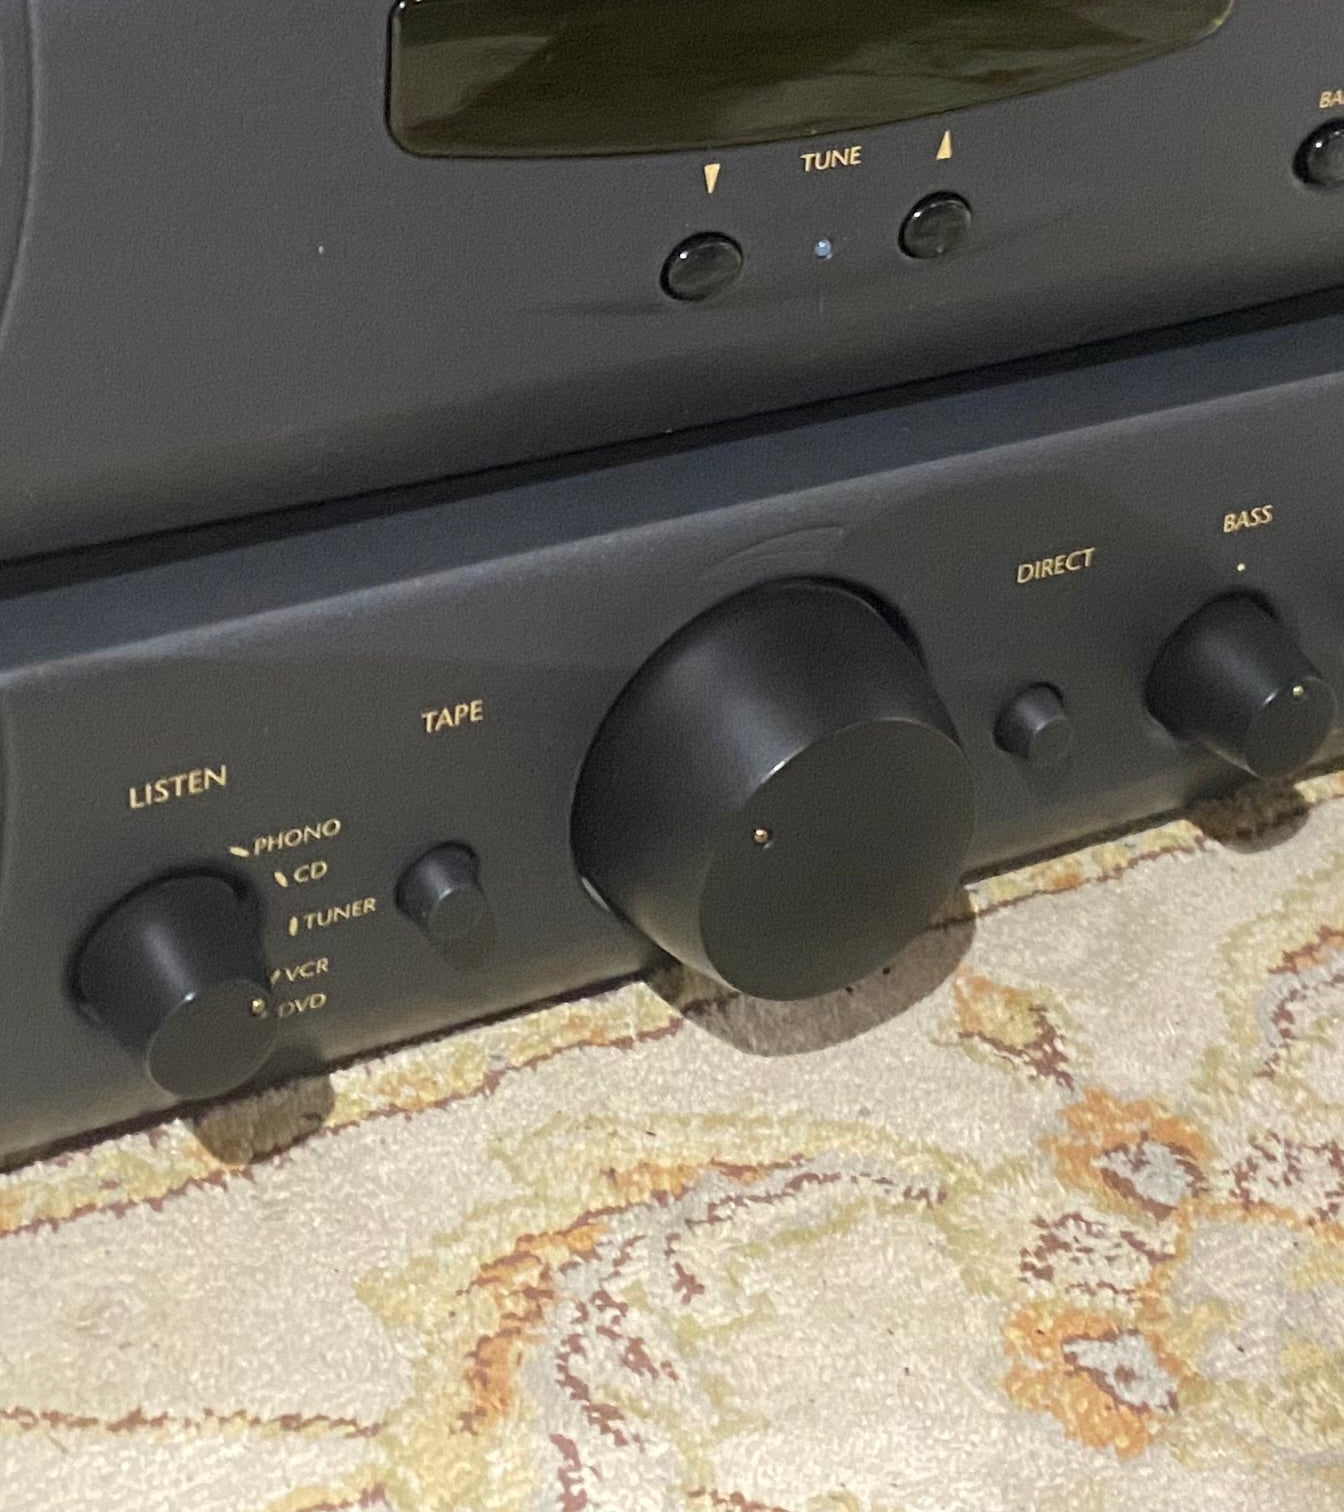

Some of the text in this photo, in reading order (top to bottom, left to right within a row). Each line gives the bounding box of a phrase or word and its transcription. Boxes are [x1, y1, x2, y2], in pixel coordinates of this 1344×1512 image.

[800, 145, 862, 172] TUNE
[1222, 503, 1274, 534] BASS
[1015, 546, 1096, 585] DIRECT
[421, 699, 484, 733] TAPE
[128, 764, 228, 810] LISTEN
[252, 817, 342, 856] PHONO
[293, 860, 328, 884] CD
[304, 896, 377, 930] TUNER
[285, 956, 330, 983] VCR
[277, 992, 327, 1019] DVD
